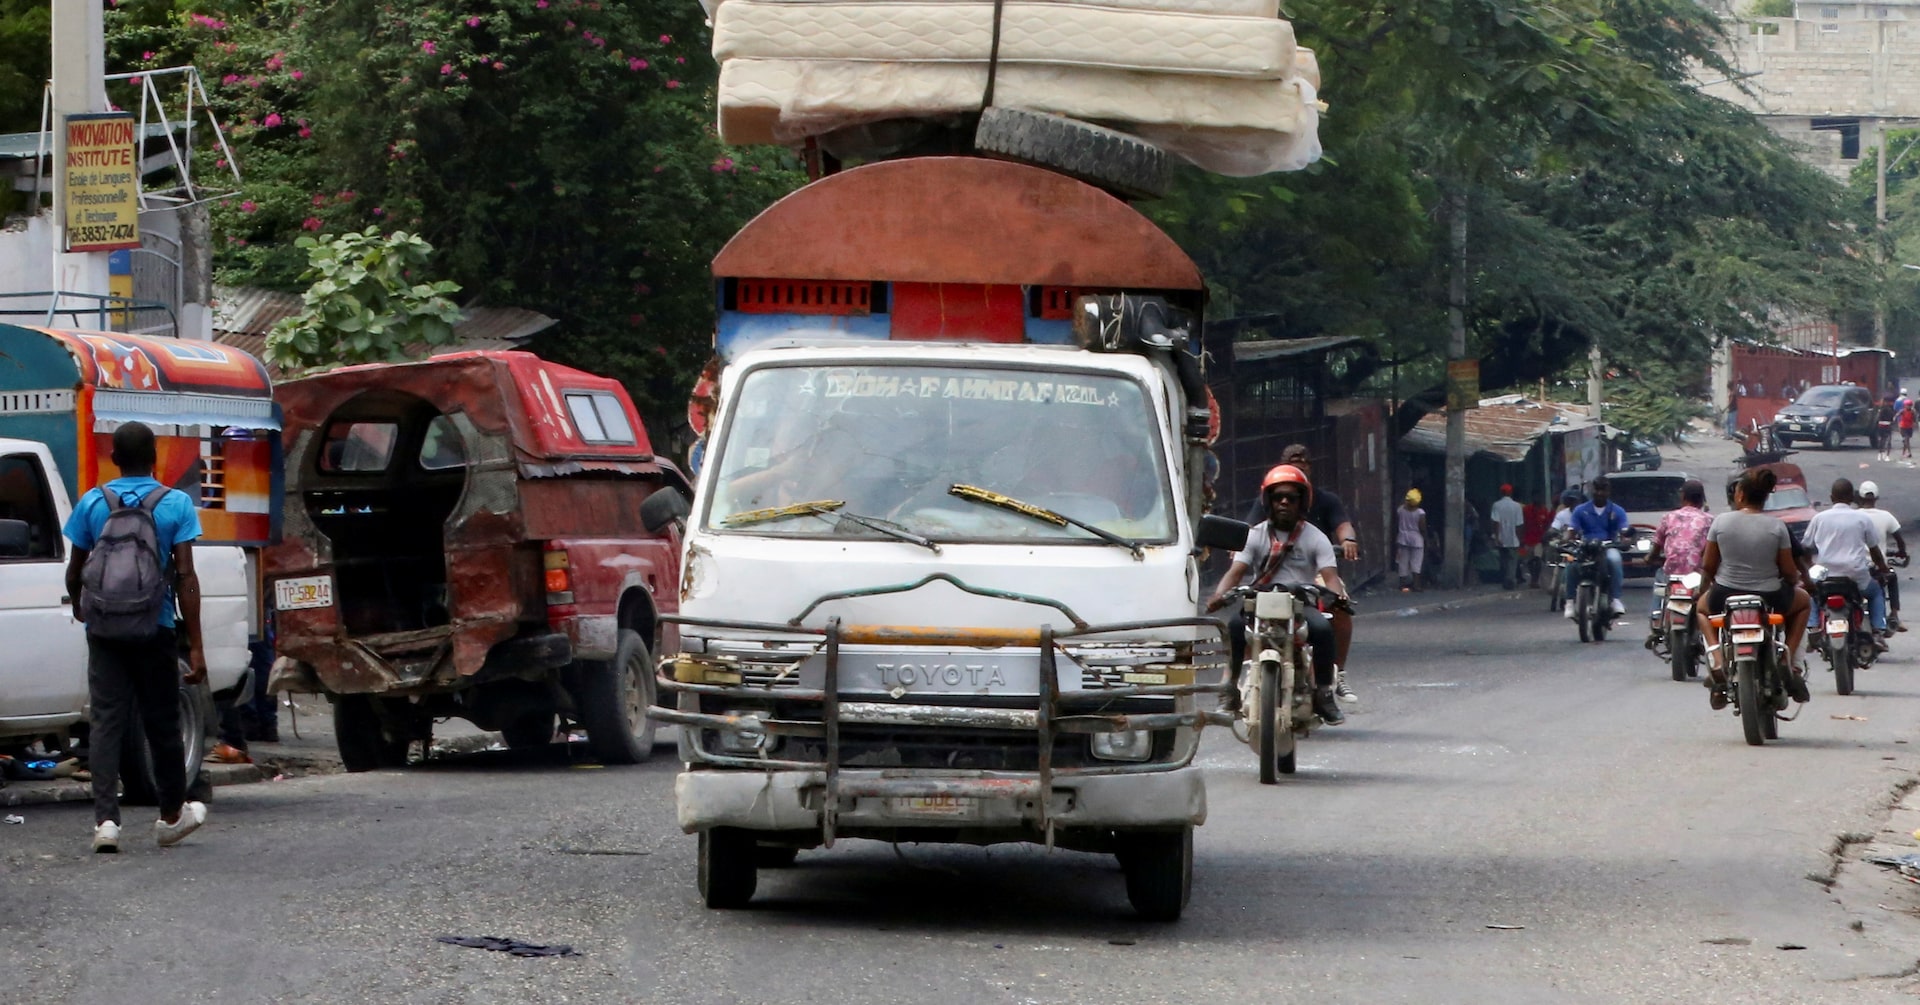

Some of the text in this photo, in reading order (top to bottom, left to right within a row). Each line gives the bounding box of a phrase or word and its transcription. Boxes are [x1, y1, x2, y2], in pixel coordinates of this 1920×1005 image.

[68, 122, 133, 146] INNOVATION
[67, 149, 131, 167] INSTITUTE
[99, 171, 131, 187] Langues
[876, 663, 1006, 686] TOYOTA
